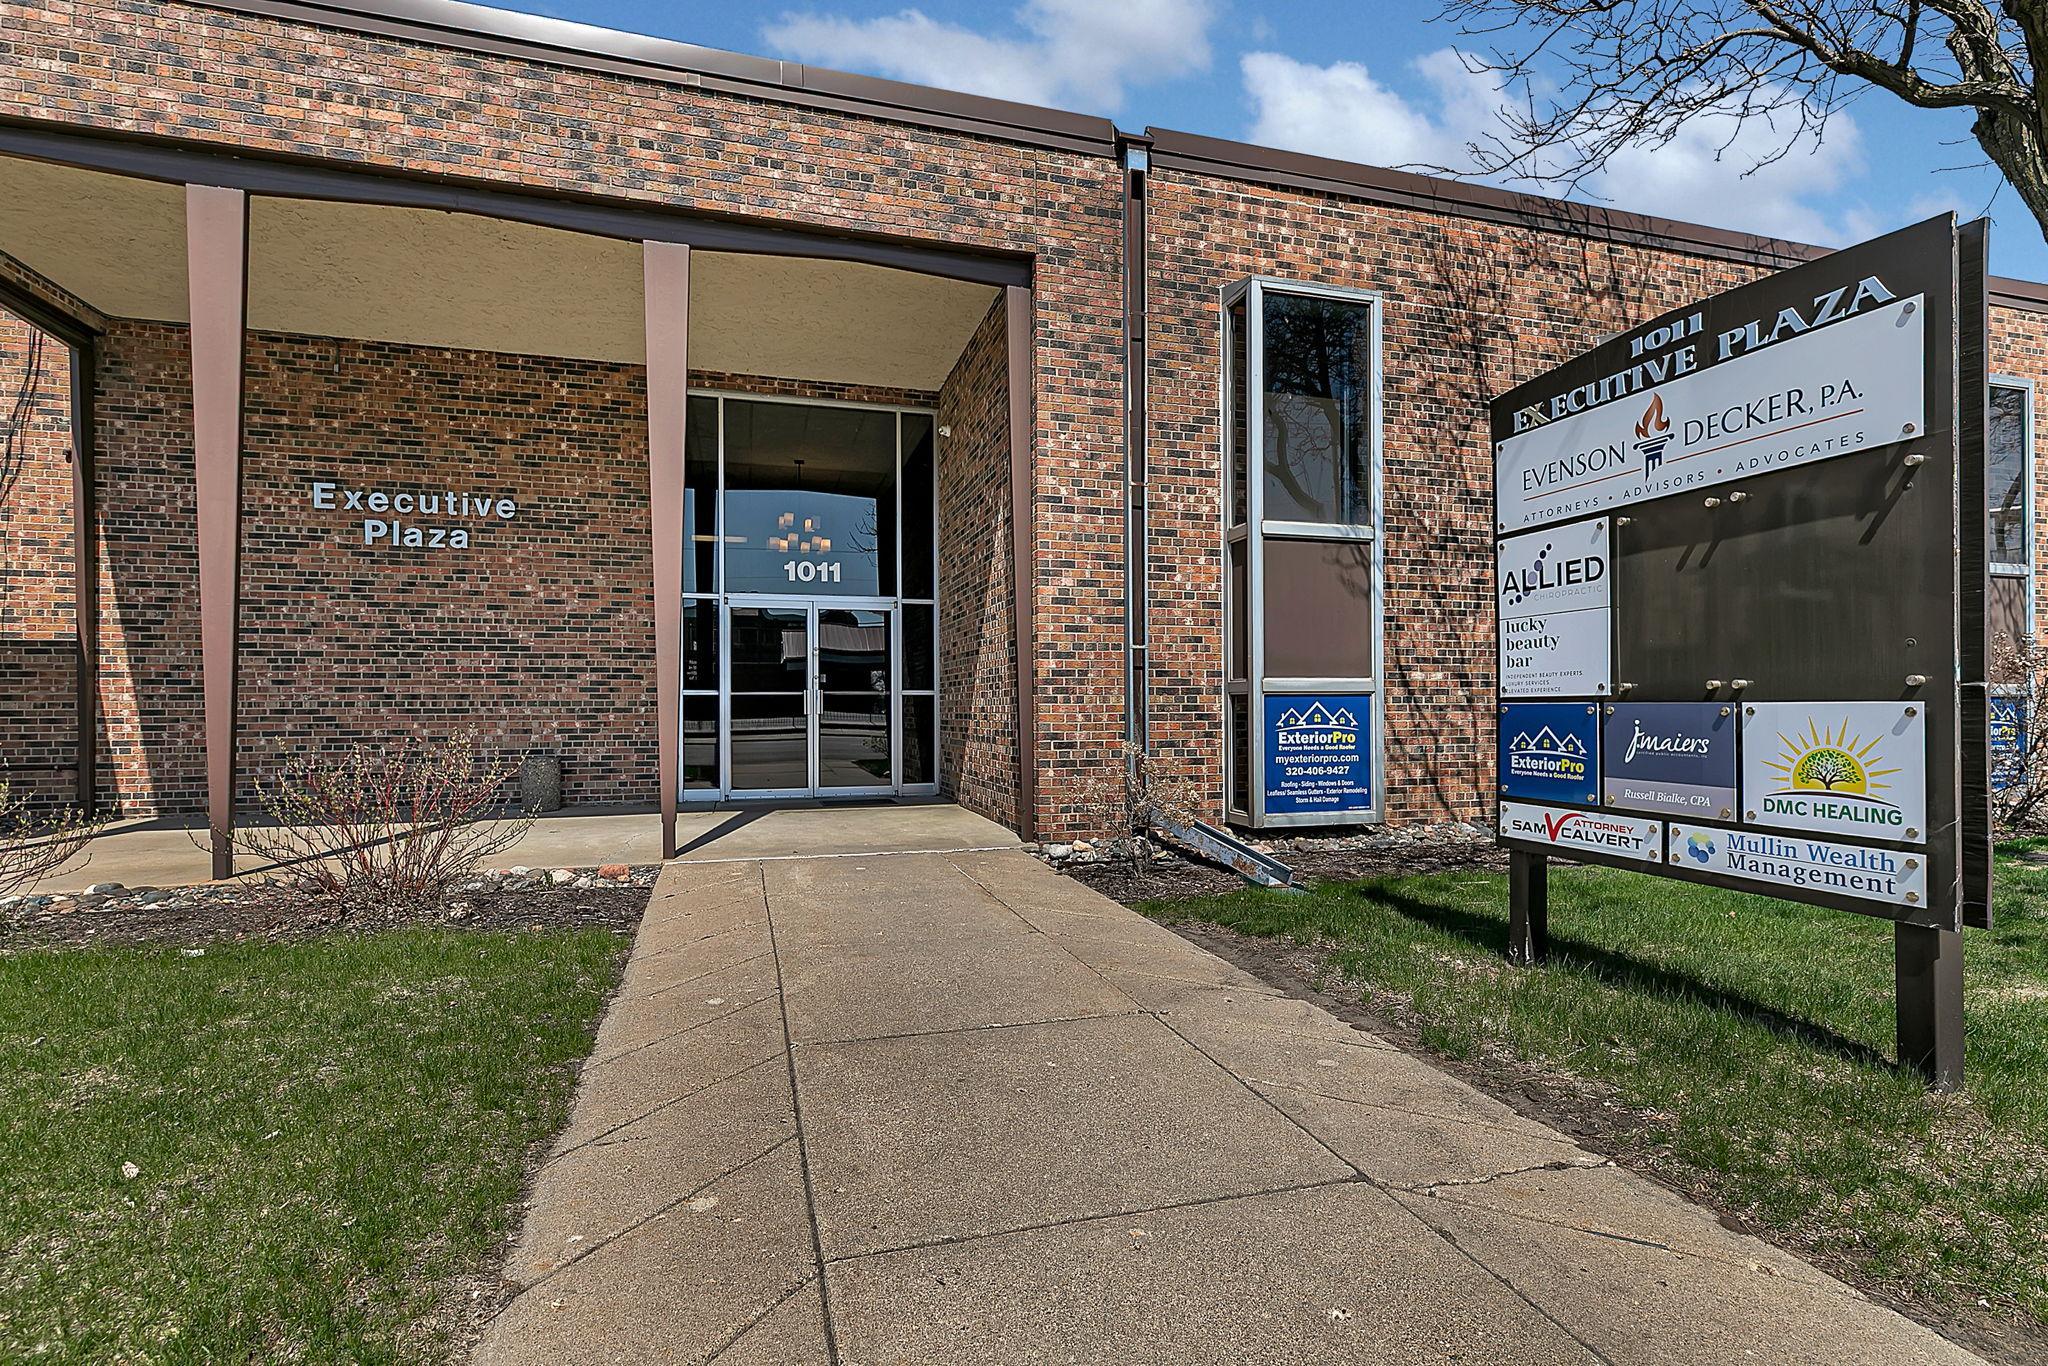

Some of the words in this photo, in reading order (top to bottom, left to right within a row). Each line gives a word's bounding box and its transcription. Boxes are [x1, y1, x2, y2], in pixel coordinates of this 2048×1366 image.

[1630, 312, 1704, 359] 1011
[1513, 345, 1698, 434] EXECUTIVE
[1718, 275, 1897, 361] PLAZA
[1522, 441, 1626, 491] EVENSON
[1684, 388, 1814, 446] DECKER,
[1820, 379, 1864, 408] P.A.
[1523, 497, 1600, 523] ATTORNEYS
[1623, 471, 1705, 499] ADVISORS
[1735, 431, 1865, 472] ADVOCATES
[312, 482, 517, 519] Executive
[364, 519, 468, 549] Plaza
[784, 560, 841, 582] 1011
[1502, 556, 1605, 596] ALLIED
[1533, 585, 1604, 601] CHIROPRACTIC
[1505, 617, 1547, 634] lucky
[1506, 635, 1560, 651] beauty
[1506, 655, 1533, 668] bar
[1278, 731, 1356, 744] ExteriorPro
[1275, 754, 1359, 765] myexteriorpro.com
[1511, 755, 1585, 773] ExteriorPro
[1285, 766, 1350, 776] 320-406-9427
[1511, 768, 1533, 776] Everyone
[1301, 780, 1315, 788] Siding
[1326, 787, 1342, 795] Exterior
[1624, 788, 1655, 800] Russell
[1656, 791, 1688, 806] Bialke,
[1690, 795, 1711, 806] CPA
[1763, 798, 1807, 816] DMC
[1813, 802, 1903, 826] HEALING
[1512, 819, 1546, 834] SAM
[1561, 827, 1644, 850] CALVERT
[1573, 819, 1634, 835] ATTORNEY
[1727, 833, 1799, 858] Mullin
[1806, 844, 1897, 873] Wealth
[1727, 852, 1897, 895] Management
